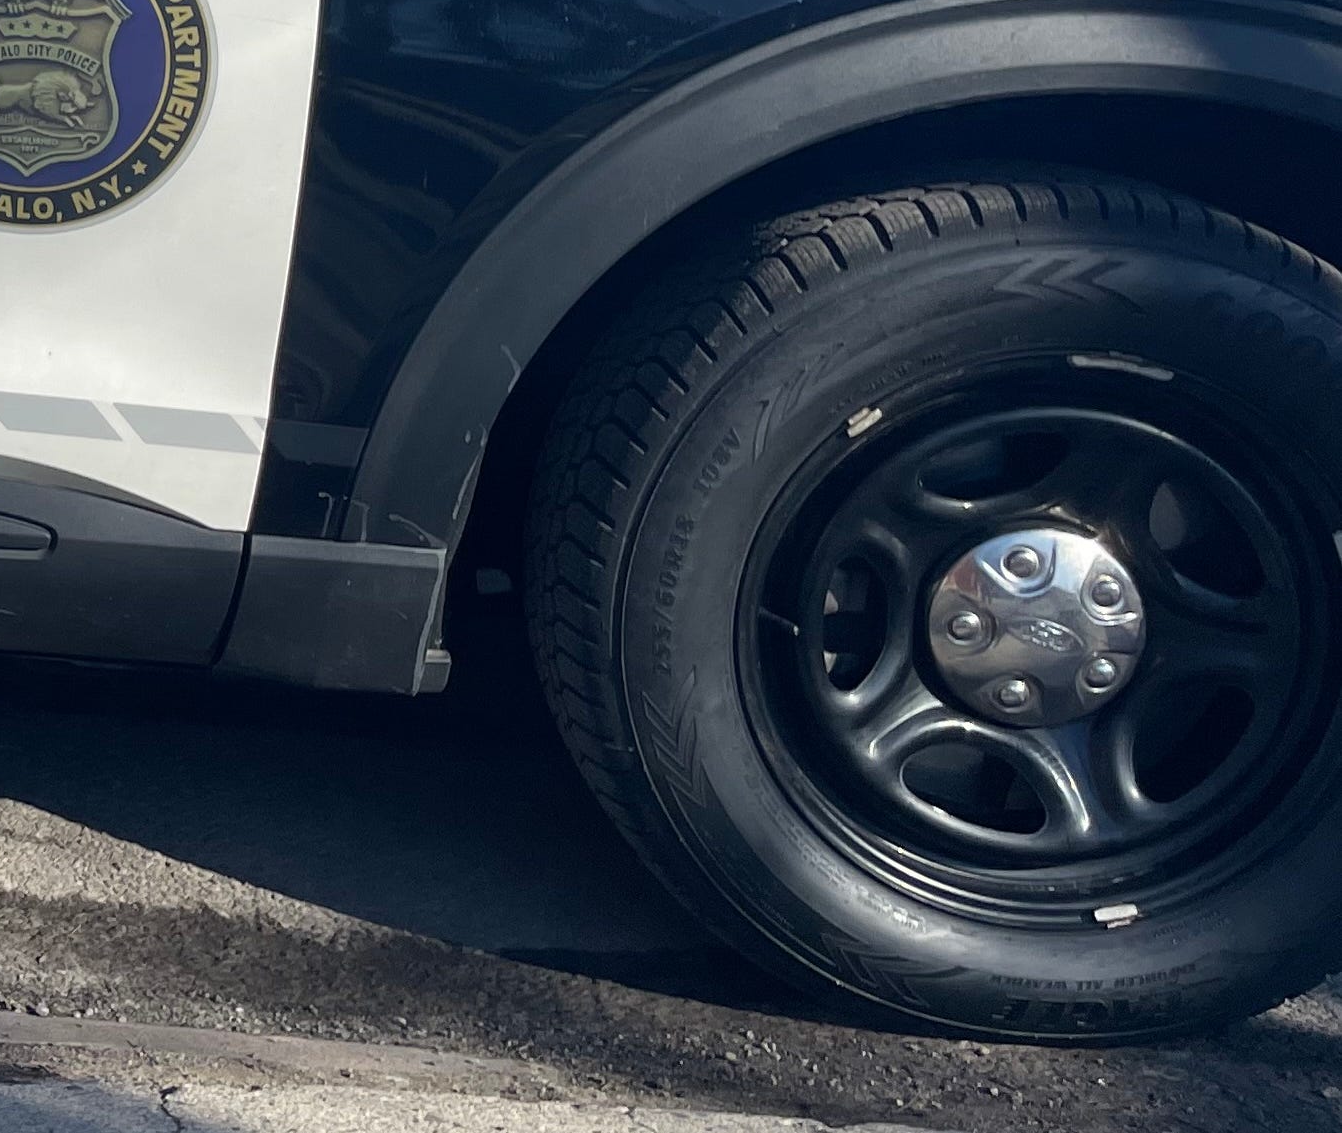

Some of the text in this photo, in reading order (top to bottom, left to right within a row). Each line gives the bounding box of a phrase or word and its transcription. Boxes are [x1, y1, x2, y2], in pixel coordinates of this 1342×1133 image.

[27, 43, 52, 57] CITY
[57, 47, 97, 73] POLICE
[70, 174, 132, 214] N.Y.
